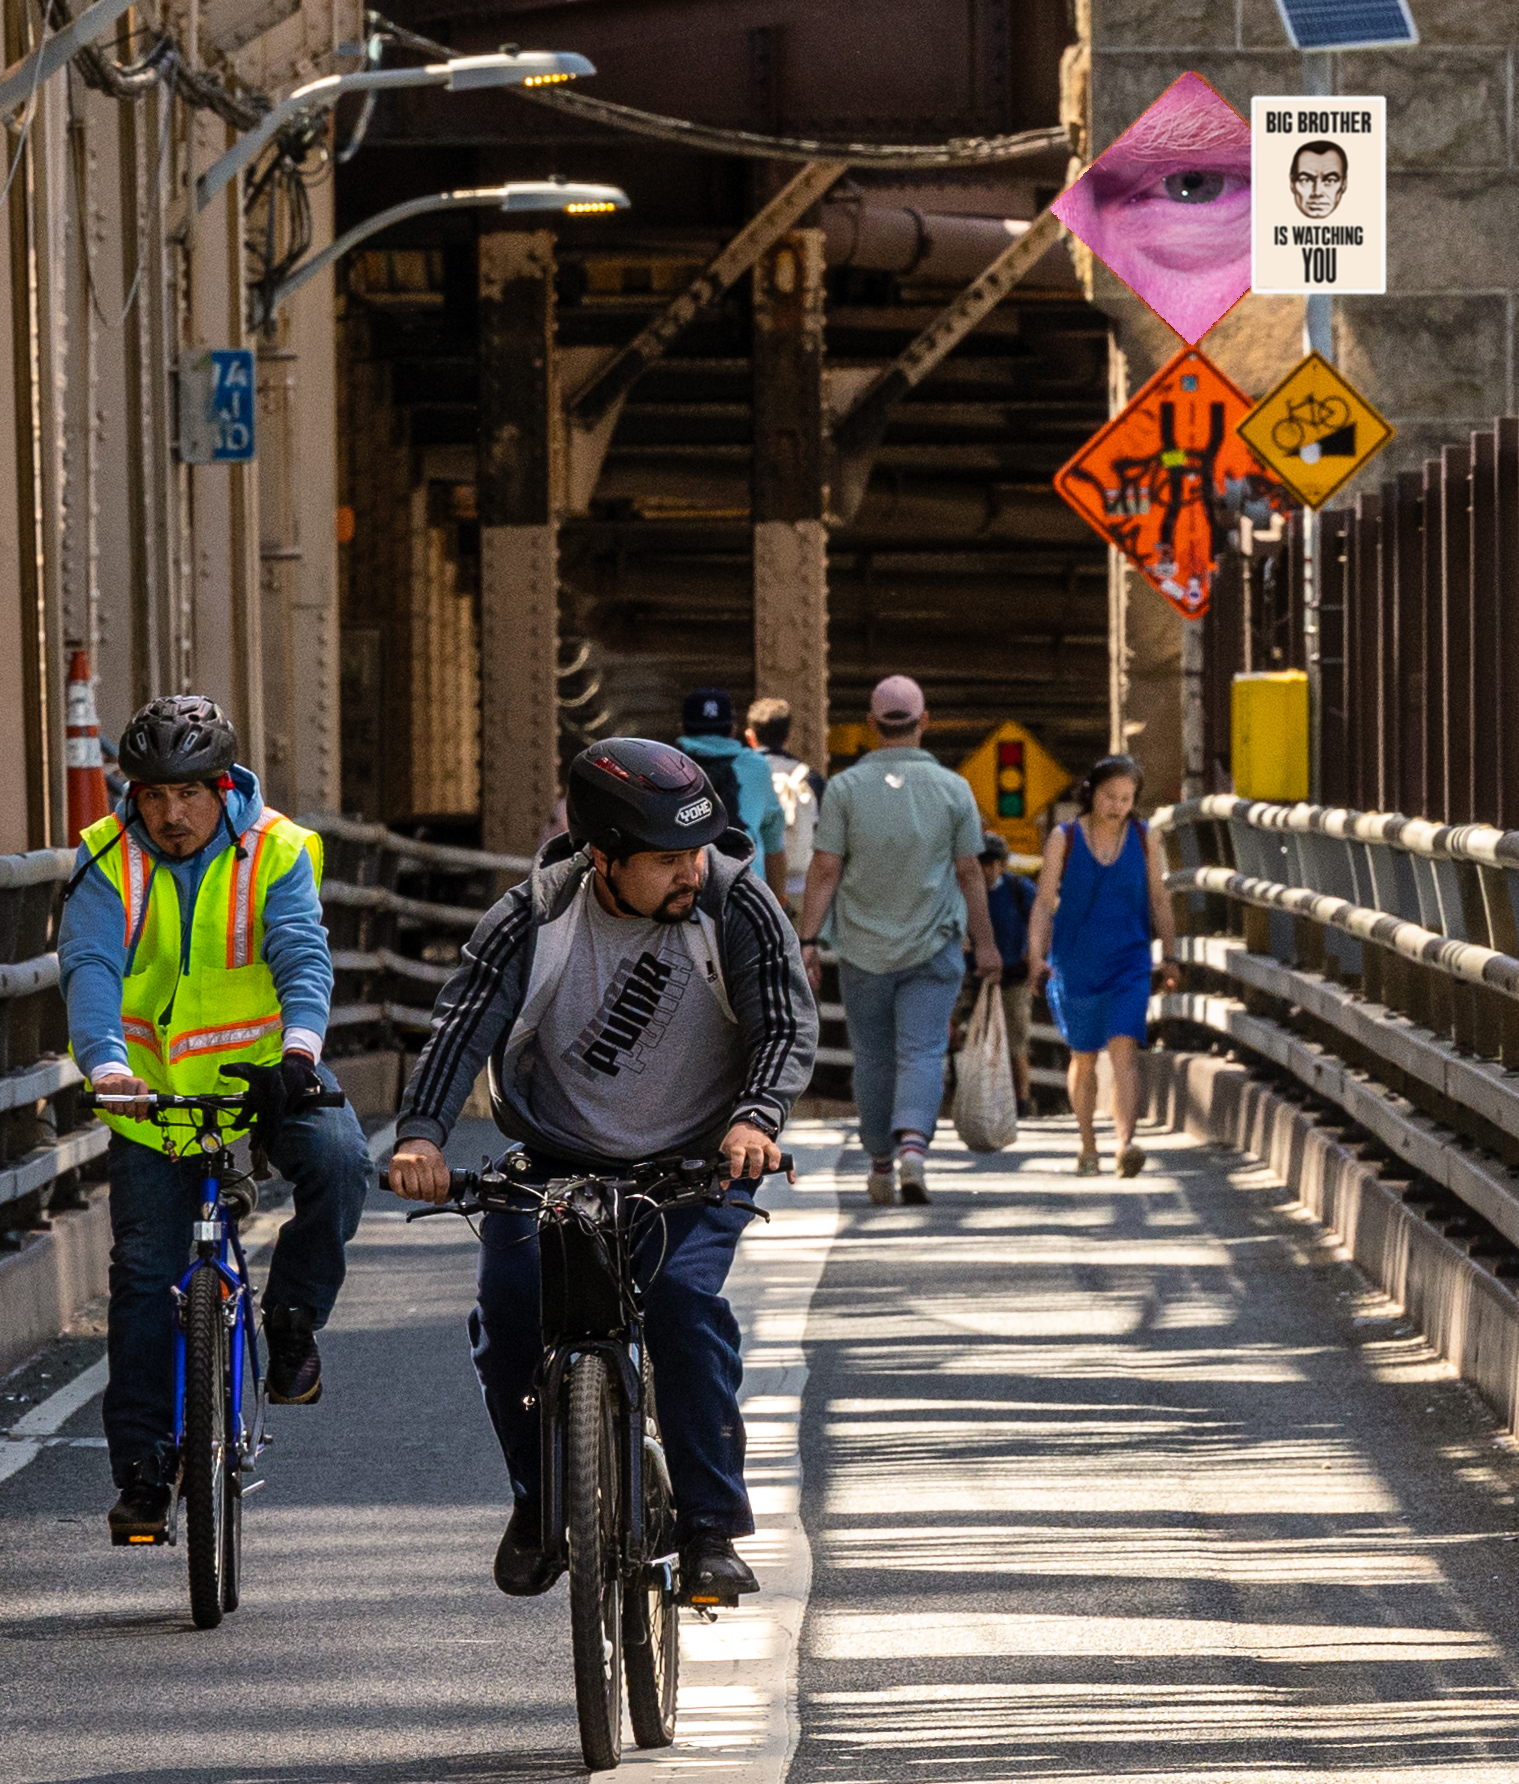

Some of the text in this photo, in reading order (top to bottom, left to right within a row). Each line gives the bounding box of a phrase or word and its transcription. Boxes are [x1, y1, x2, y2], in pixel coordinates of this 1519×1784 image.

[1266, 111, 1372, 134] BIG BROTHER
[1274, 226, 1364, 246] IS WATCHING
[1302, 247, 1337, 284] YOU
[681, 802, 711, 823] YOHE
[582, 951, 672, 1078] PUMA
